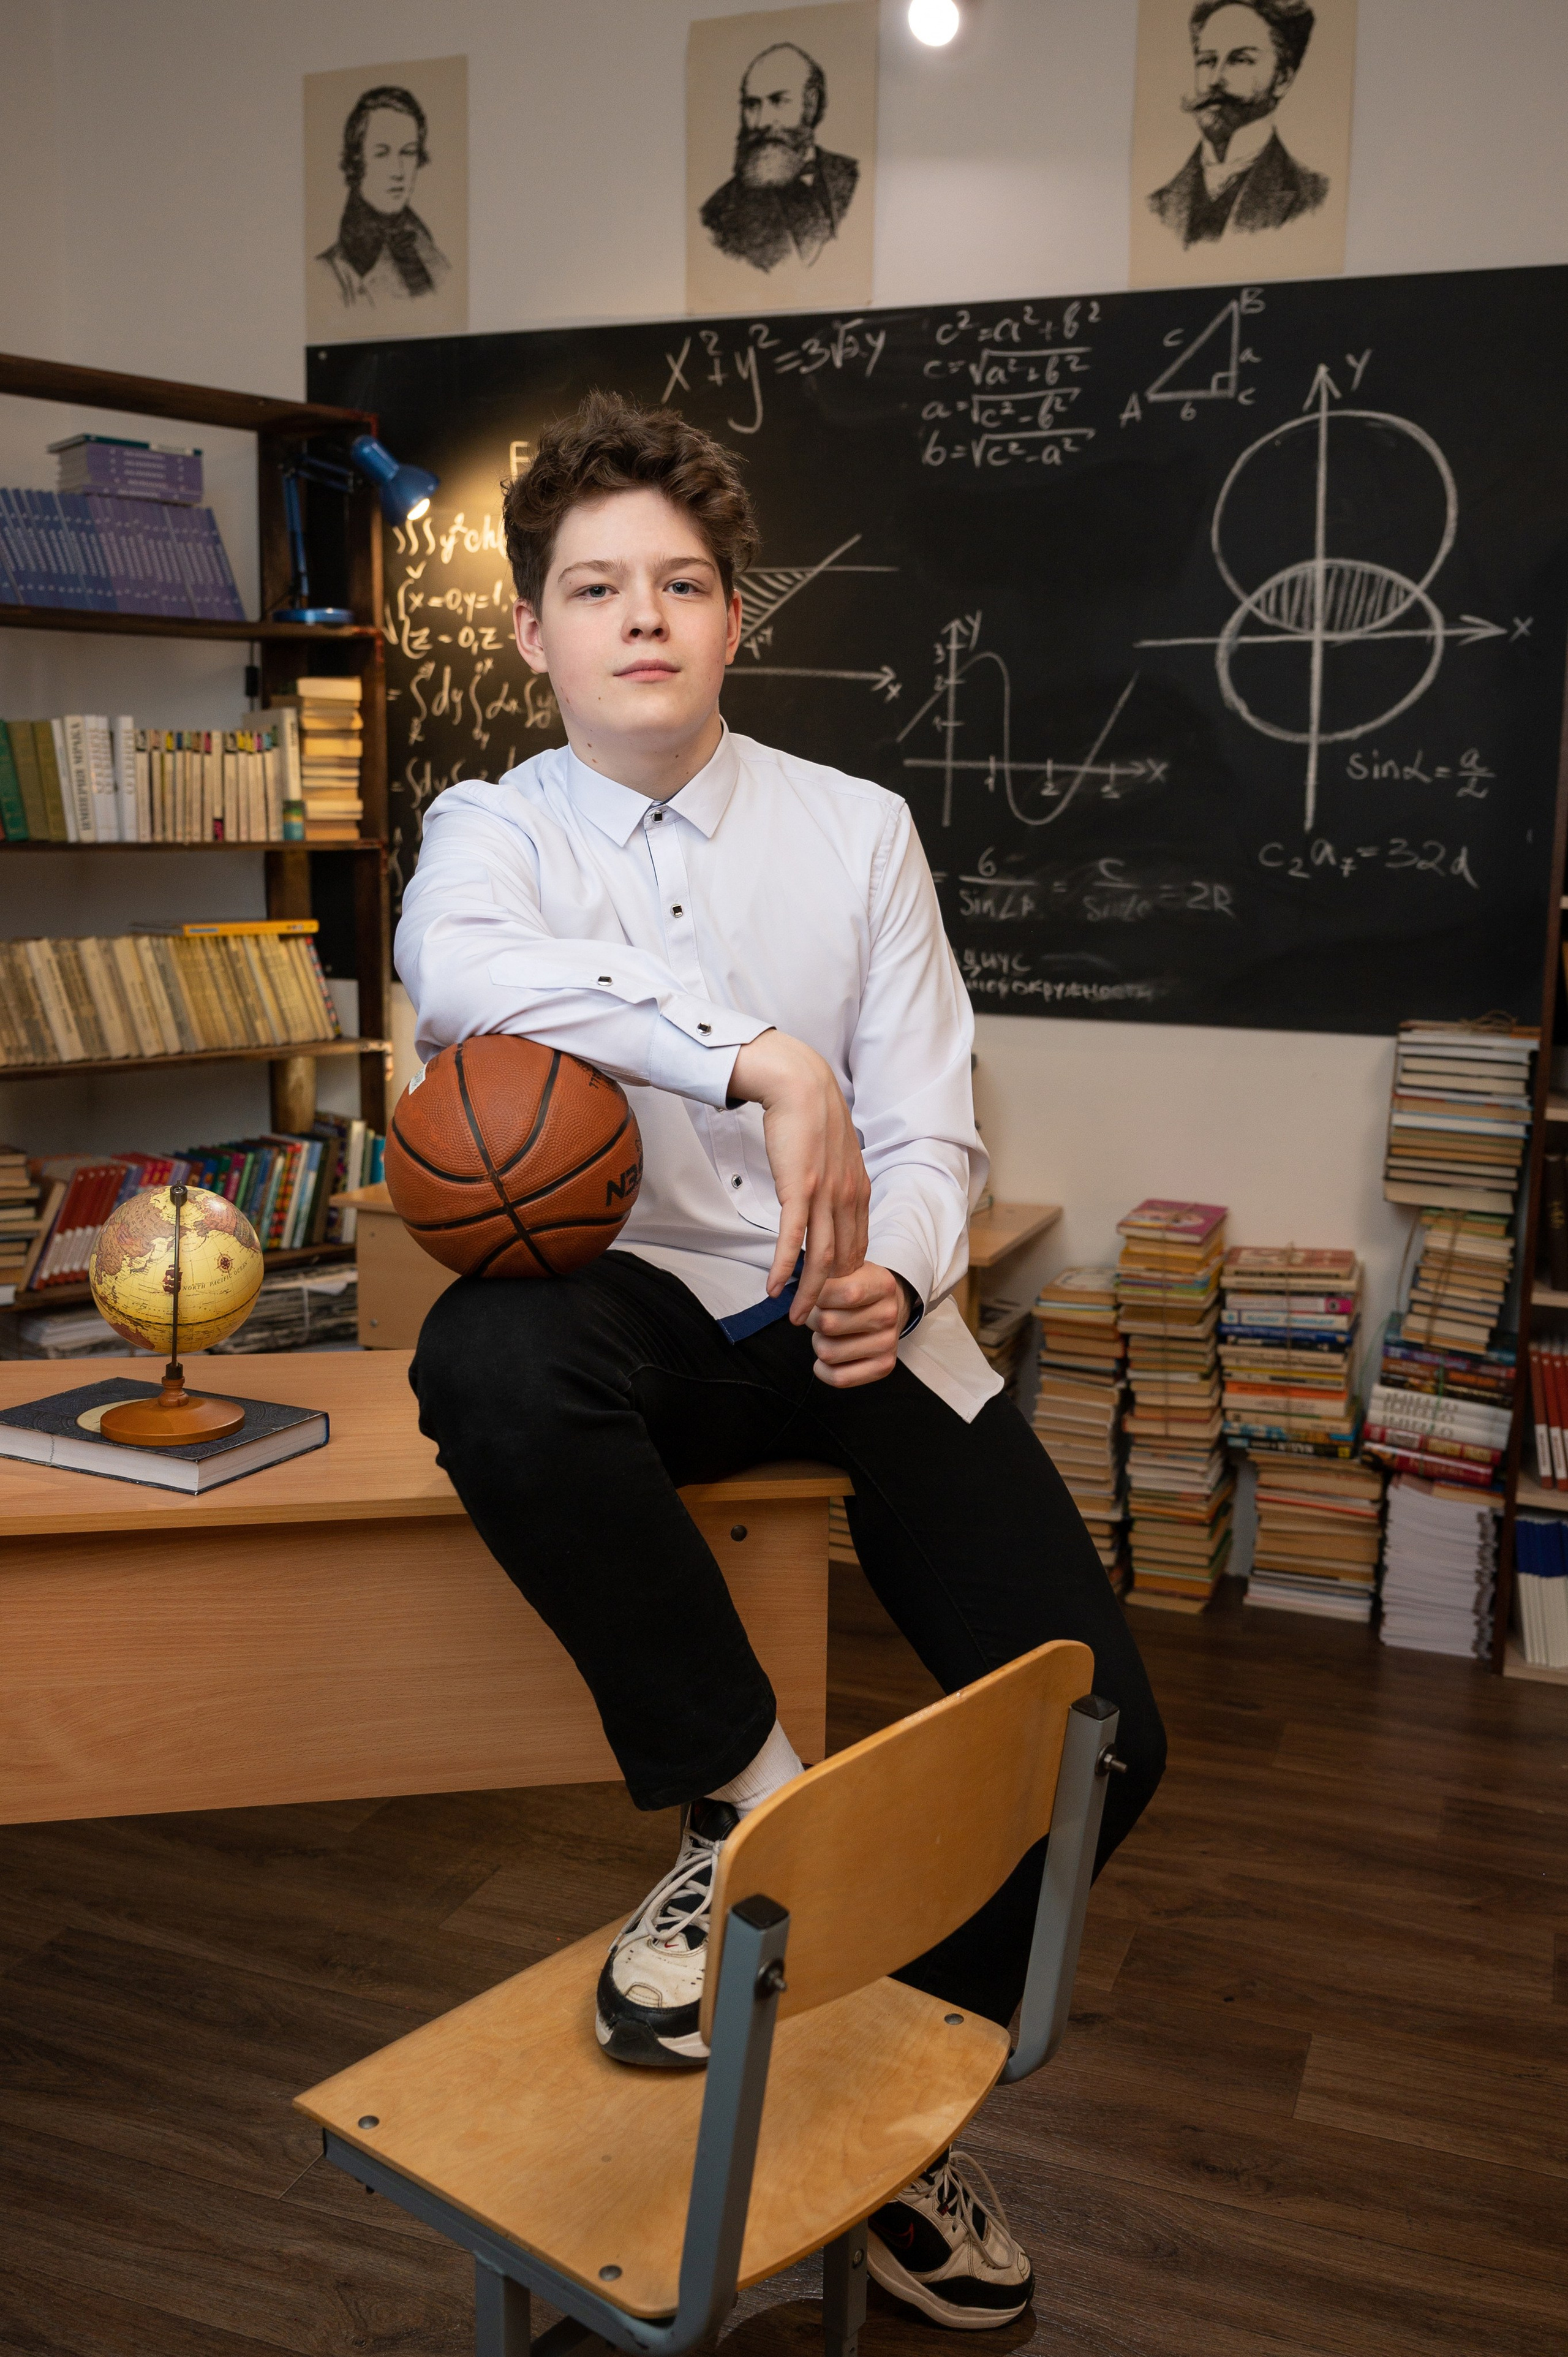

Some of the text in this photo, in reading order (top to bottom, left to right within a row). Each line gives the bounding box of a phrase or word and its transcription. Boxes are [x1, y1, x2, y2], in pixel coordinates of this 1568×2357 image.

[1120, 392, 1142, 428] A
[182, 1261, 248, 1292] NORTH PACIFIC OCEAN
